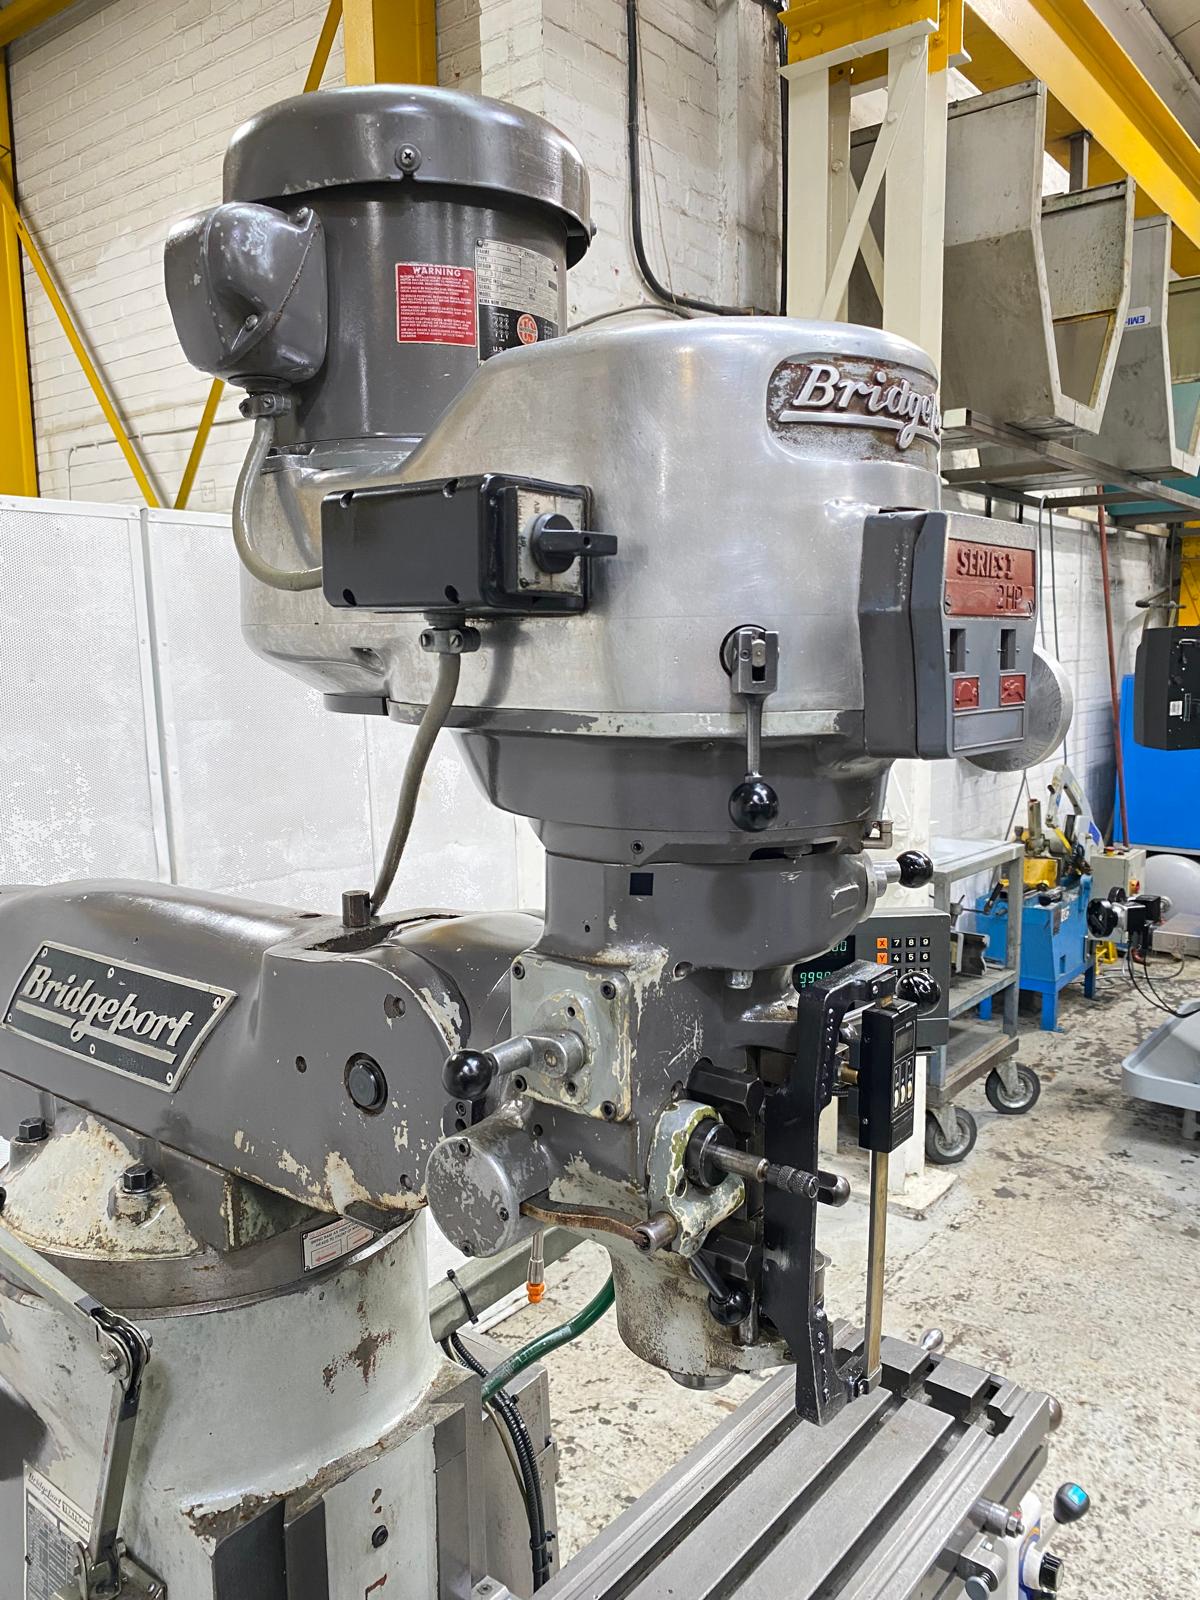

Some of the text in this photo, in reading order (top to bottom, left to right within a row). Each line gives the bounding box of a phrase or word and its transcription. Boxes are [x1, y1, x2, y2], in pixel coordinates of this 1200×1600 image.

[413, 266, 461, 277] WARNING
[957, 546, 1006, 579] SERIES
[879, 938, 929, 947] X 7 8 9
[879, 954, 885, 962] Y
[893, 954, 900, 962] 4
[908, 953, 914, 961] 5
[20, 964, 193, 1047] Bridgeport
